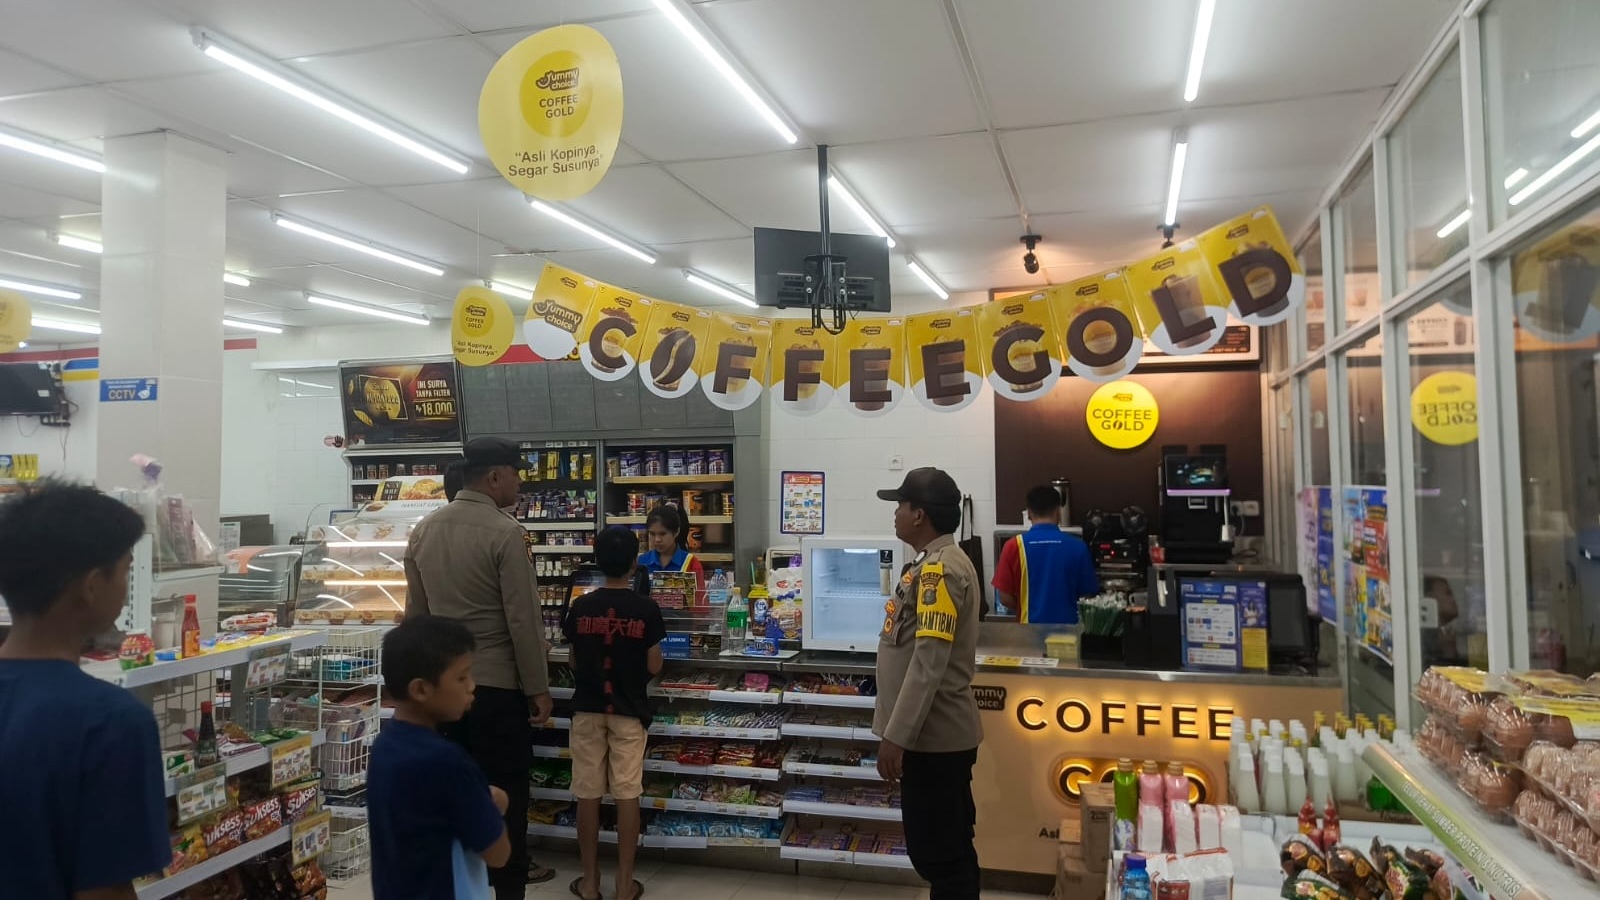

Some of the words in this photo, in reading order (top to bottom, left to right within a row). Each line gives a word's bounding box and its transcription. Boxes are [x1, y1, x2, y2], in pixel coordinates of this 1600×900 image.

[537, 68, 579, 88] Yummy
[539, 94, 579, 108] COFFEE
[545, 106, 575, 118] GOLD
[508, 164, 549, 179] Segar
[533, 300, 582, 324] Yummy
[109, 390, 135, 399] CCTV
[422, 402, 453, 415] 18.000
[1092, 408, 1152, 420] COFFEE
[1101, 420, 1145, 431] GOLD
[973, 687, 1004, 699] mmy
[977, 698, 999, 708] oice
[1016, 696, 1234, 741] COFFEE
[1039, 827, 1060, 839] Asl
[1432, 809, 1459, 837] SUMBER
[1455, 830, 1488, 864] PROTEIN
[1486, 862, 1522, 900] NUTRISI
